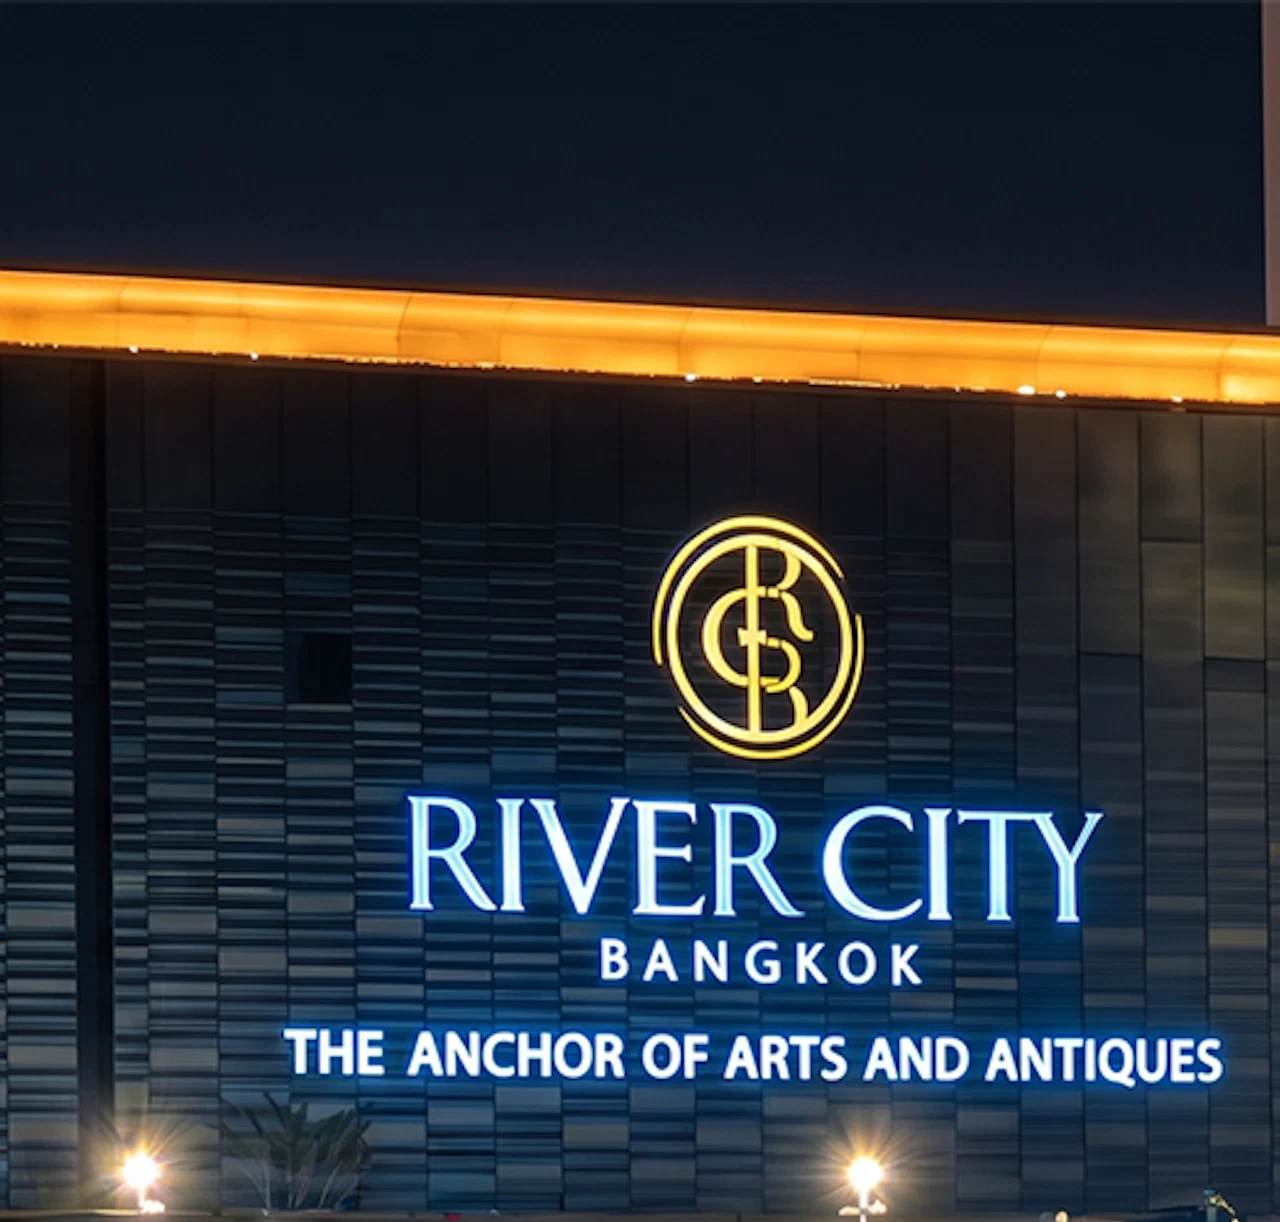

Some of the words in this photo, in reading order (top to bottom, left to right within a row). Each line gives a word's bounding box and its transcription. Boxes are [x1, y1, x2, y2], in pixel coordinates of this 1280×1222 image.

[407, 796, 803, 917] RIVER
[822, 805, 1104, 924] CITY
[600, 937, 922, 986] BANGKOK
[283, 1028, 385, 1075] THE
[407, 1030, 625, 1079] ANCHOR
[642, 1033, 709, 1081] OF
[724, 1035, 848, 1082] ARTS
[863, 1036, 970, 1083] AND
[984, 1037, 1223, 1088] ANTIQUES
